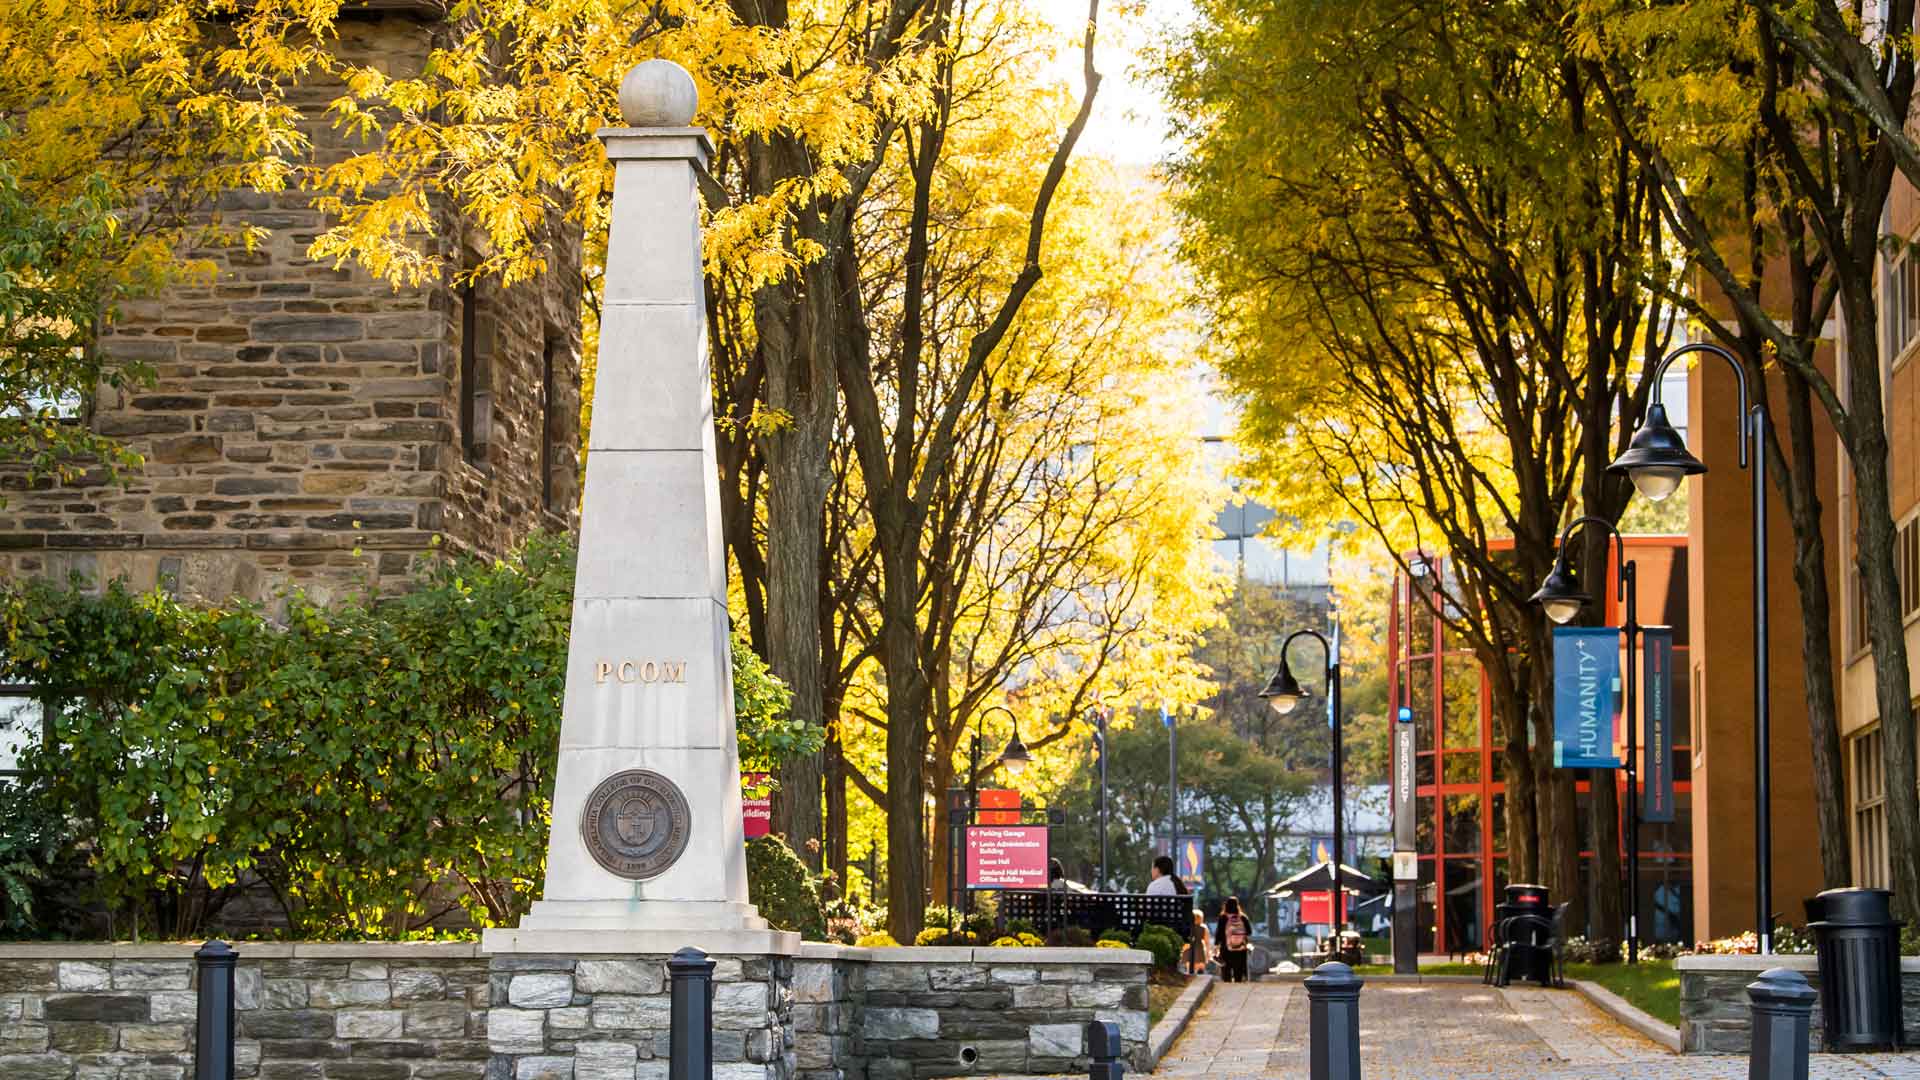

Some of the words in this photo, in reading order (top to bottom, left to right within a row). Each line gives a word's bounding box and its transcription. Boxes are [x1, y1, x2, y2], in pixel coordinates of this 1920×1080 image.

[595, 661, 687, 683] PCOM
[743, 809, 771, 820] uilding
[979, 847, 1004, 855] Building
[999, 876, 1024, 884] Building
